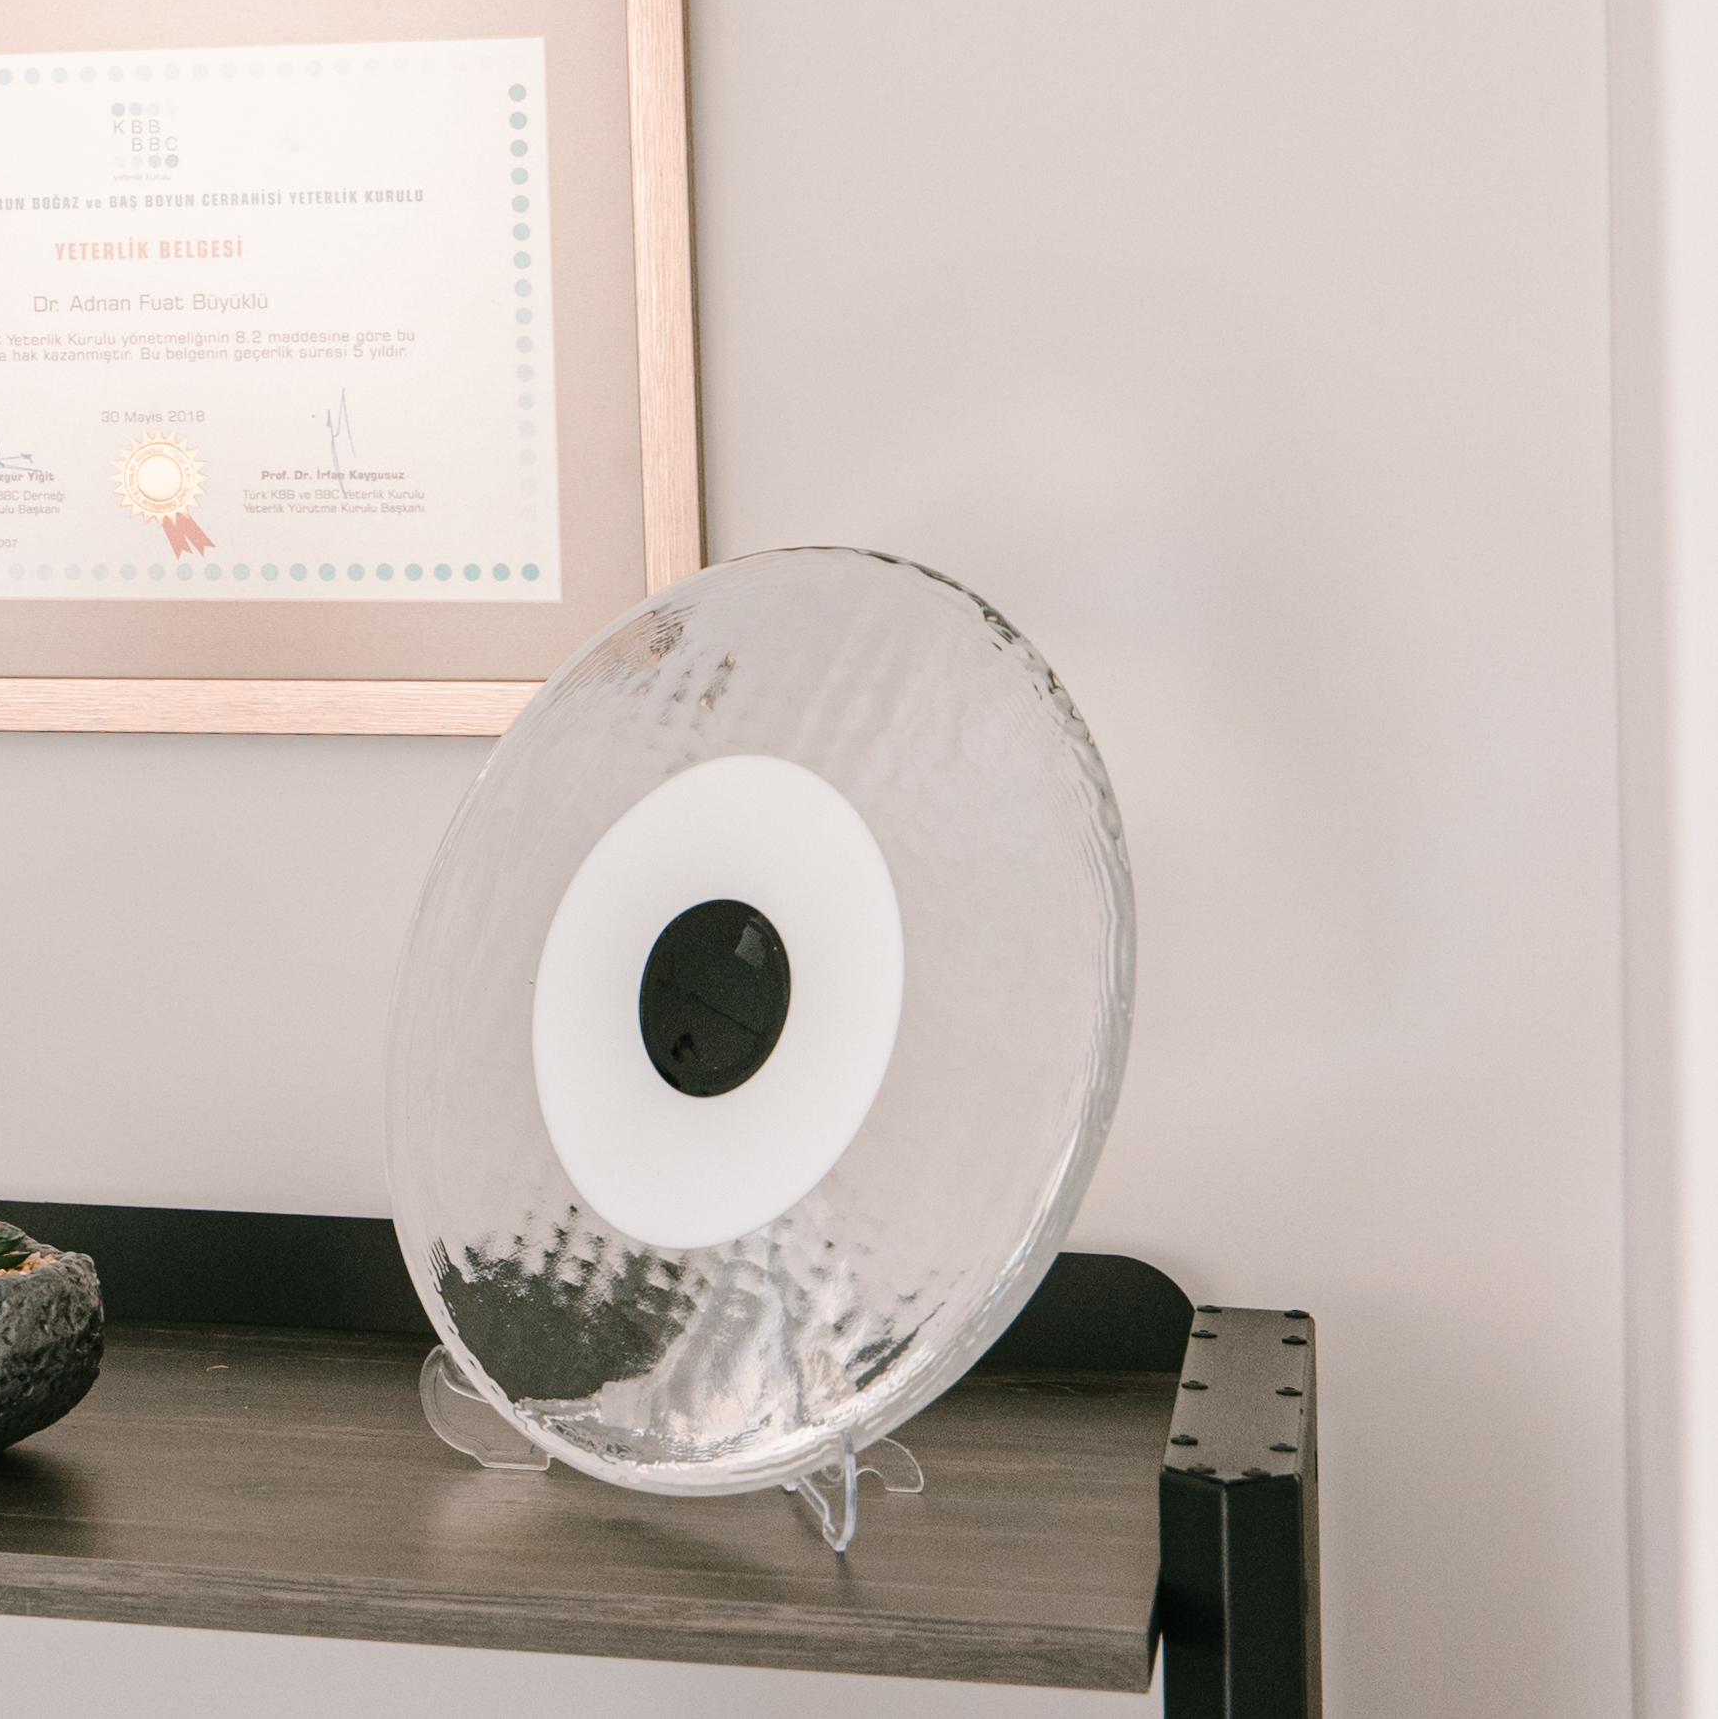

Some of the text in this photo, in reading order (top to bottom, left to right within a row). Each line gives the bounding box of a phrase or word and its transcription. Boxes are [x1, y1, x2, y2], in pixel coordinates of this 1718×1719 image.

[32, 194, 79, 210] BOĞAZ
[86, 200, 102, 209] ve
[109, 195, 137, 211] BAŞ
[145, 194, 194, 207] BOYUN
[202, 189, 282, 207] CERRAHİSİ
[289, 188, 358, 204] YETERLİK
[365, 189, 423, 203] KURULU
[55, 235, 242, 261] YETERLİK BELGESİ
[33, 293, 268, 314] Dr. Adnan Fuat Büyüklü
[6, 334, 62, 346] Yeterlik
[68, 333, 116, 346] Kurulu
[121, 332, 230, 348] yönetmeliğinin
[235, 330, 262, 344] 8.2
[268, 330, 350, 343] maddesine
[356, 330, 391, 346] göre
[397, 330, 415, 341] bu
[13, 349, 37, 361] hak
[43, 349, 132, 364] kazanmıştır.
[140, 347, 160, 360] Bu
[166, 347, 228, 363] belgenin
[234, 346, 293, 362] geçerlik
[299, 347, 347, 359] süresi
[354, 345, 363, 358] 5
[369, 345, 407, 360] yıldır.
[101, 410, 205, 425] 30 Mayıs 2018
[261, 470, 289, 480] Prof.
[294, 470, 312, 480] Dr.
[349, 470, 404, 482] Kaygusuz
